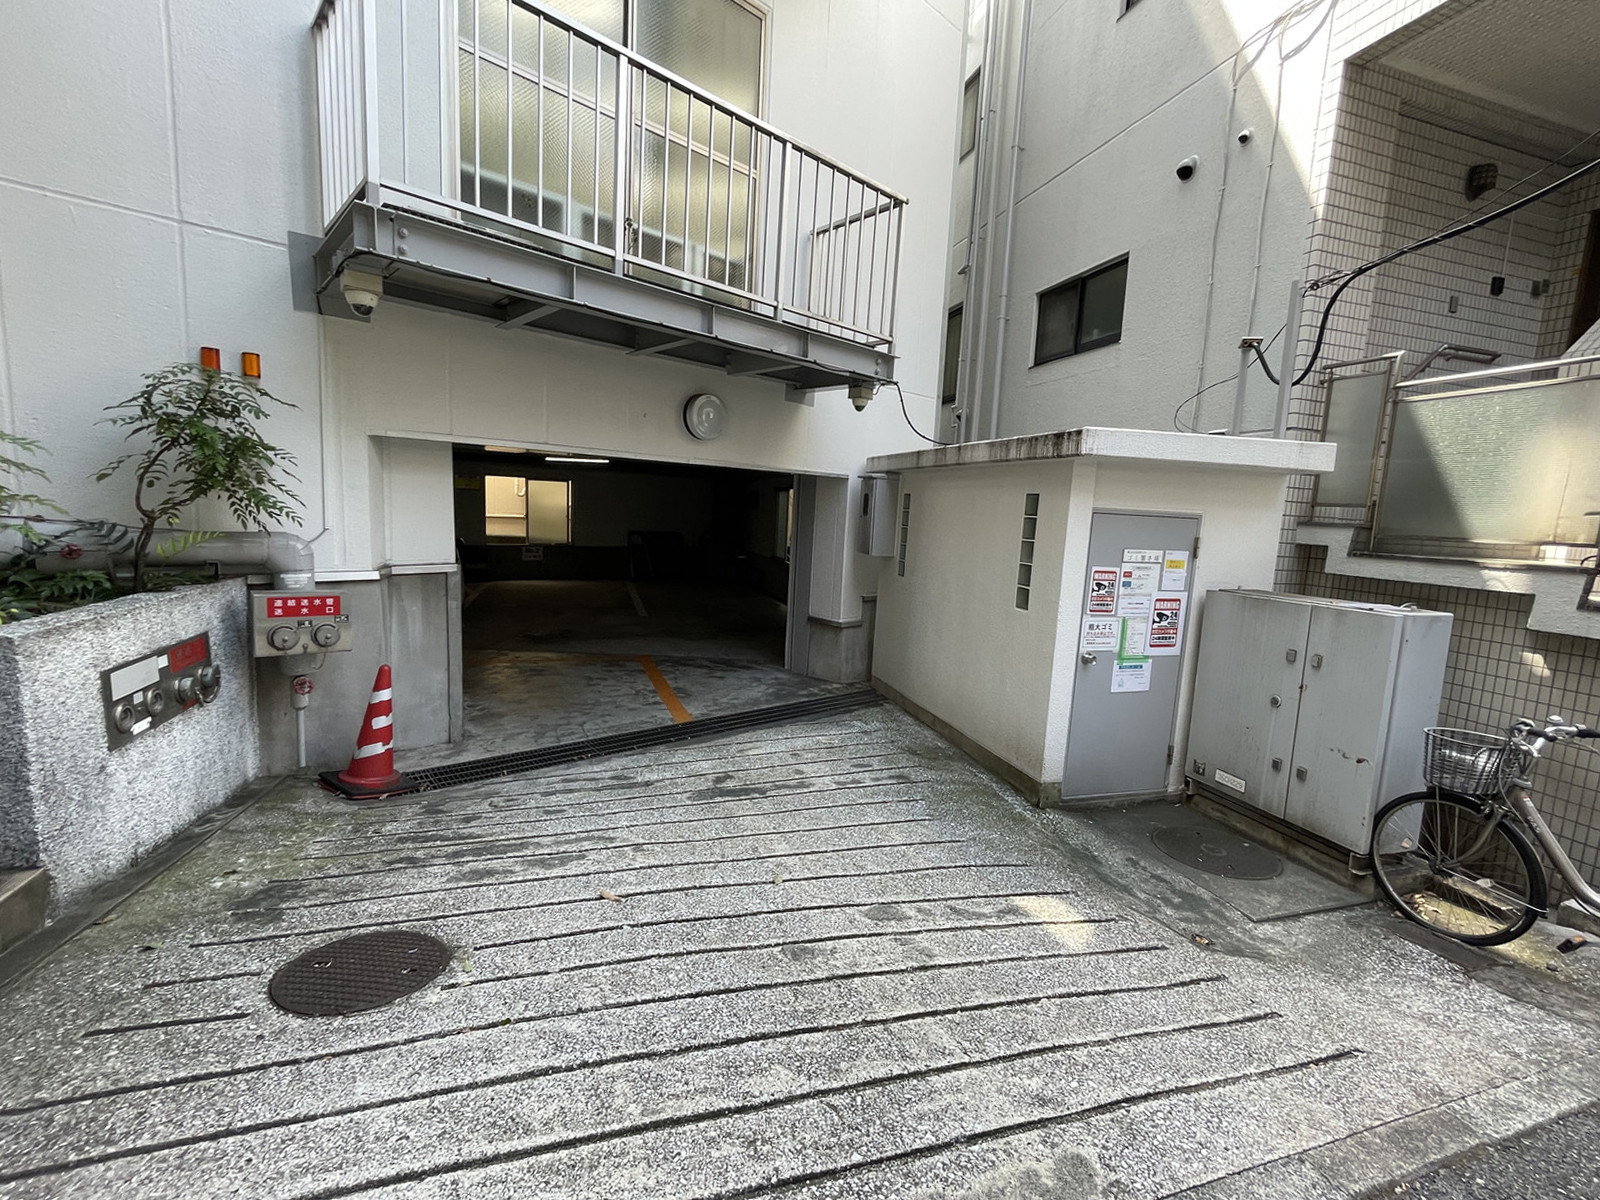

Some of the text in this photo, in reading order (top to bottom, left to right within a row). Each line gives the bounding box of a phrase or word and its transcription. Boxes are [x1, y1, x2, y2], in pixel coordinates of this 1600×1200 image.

[273, 598, 334, 607] 連結送水管
[1155, 601, 1179, 609] WARNING
[1088, 623, 1112, 631] 粗大ゴミ
